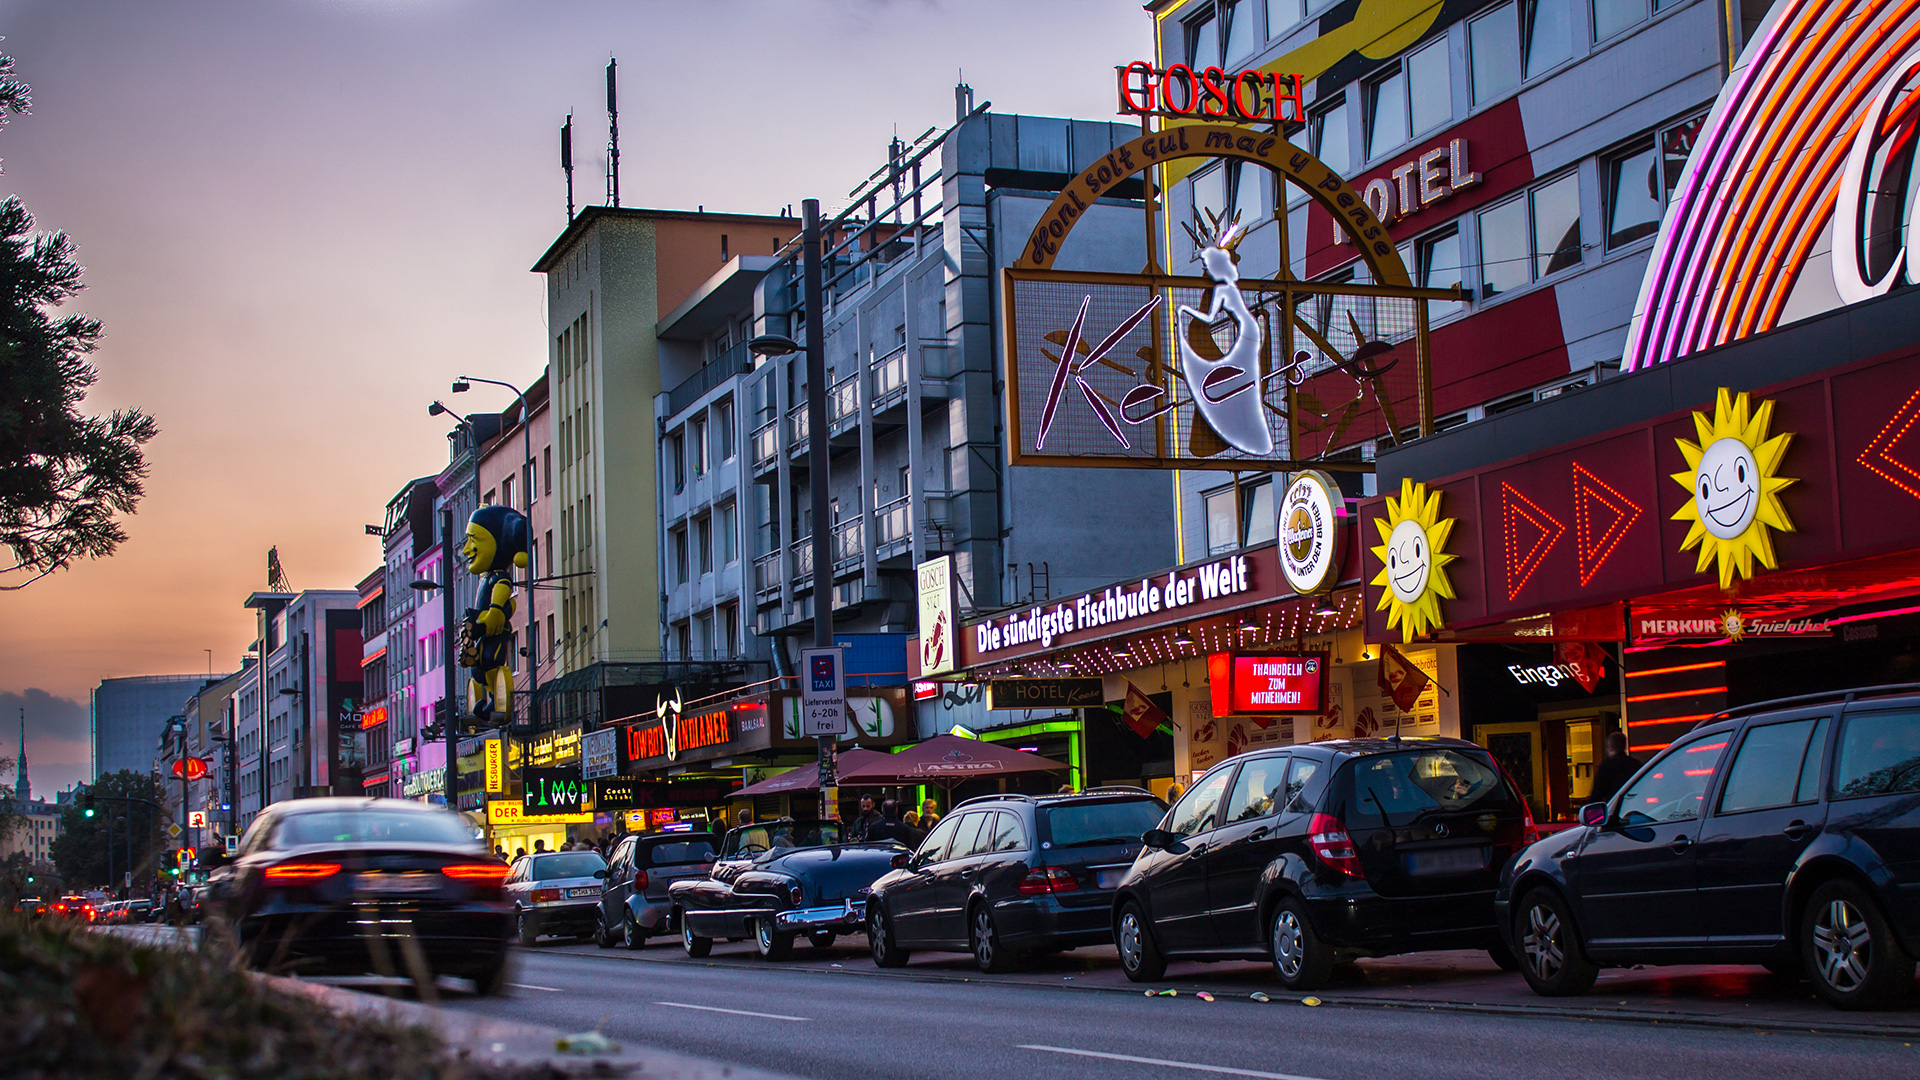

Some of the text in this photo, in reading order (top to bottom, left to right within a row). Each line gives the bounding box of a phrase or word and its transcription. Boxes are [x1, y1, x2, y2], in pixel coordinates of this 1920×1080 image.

[1122, 61, 1306, 122] GOSCH
[1032, 190, 1086, 264] Honi
[1085, 145, 1134, 193] soit
[1205, 131, 1275, 157] mal
[1318, 172, 1391, 257] pense
[1311, 501, 1323, 538] BIEREN
[1313, 541, 1323, 564] DEN
[920, 565, 945, 591] GOSCH
[976, 555, 1248, 653] Die sündigste Fischbude der Welt
[1641, 618, 1832, 635] MERKUR Spielothek
[1253, 663, 1302, 676] THAINUDELN
[1507, 662, 1590, 687] Eingang
[814, 680, 834, 688] TAXI
[1268, 678, 1285, 690] ZUM
[1016, 685, 1065, 699] HOTEL
[1250, 691, 1301, 704] MITNEHMEN!
[805, 698, 843, 706] Lieferverkehr
[340, 712, 362, 721] MO
[812, 708, 838, 718] 6-20h
[817, 721, 834, 730] frei
[627, 724, 665, 761] COWBOY
[675, 710, 730, 751] INDIANER
[489, 742, 499, 790] HESBURGER
[926, 763, 995, 771] ASTRA
[495, 807, 519, 818] DER
